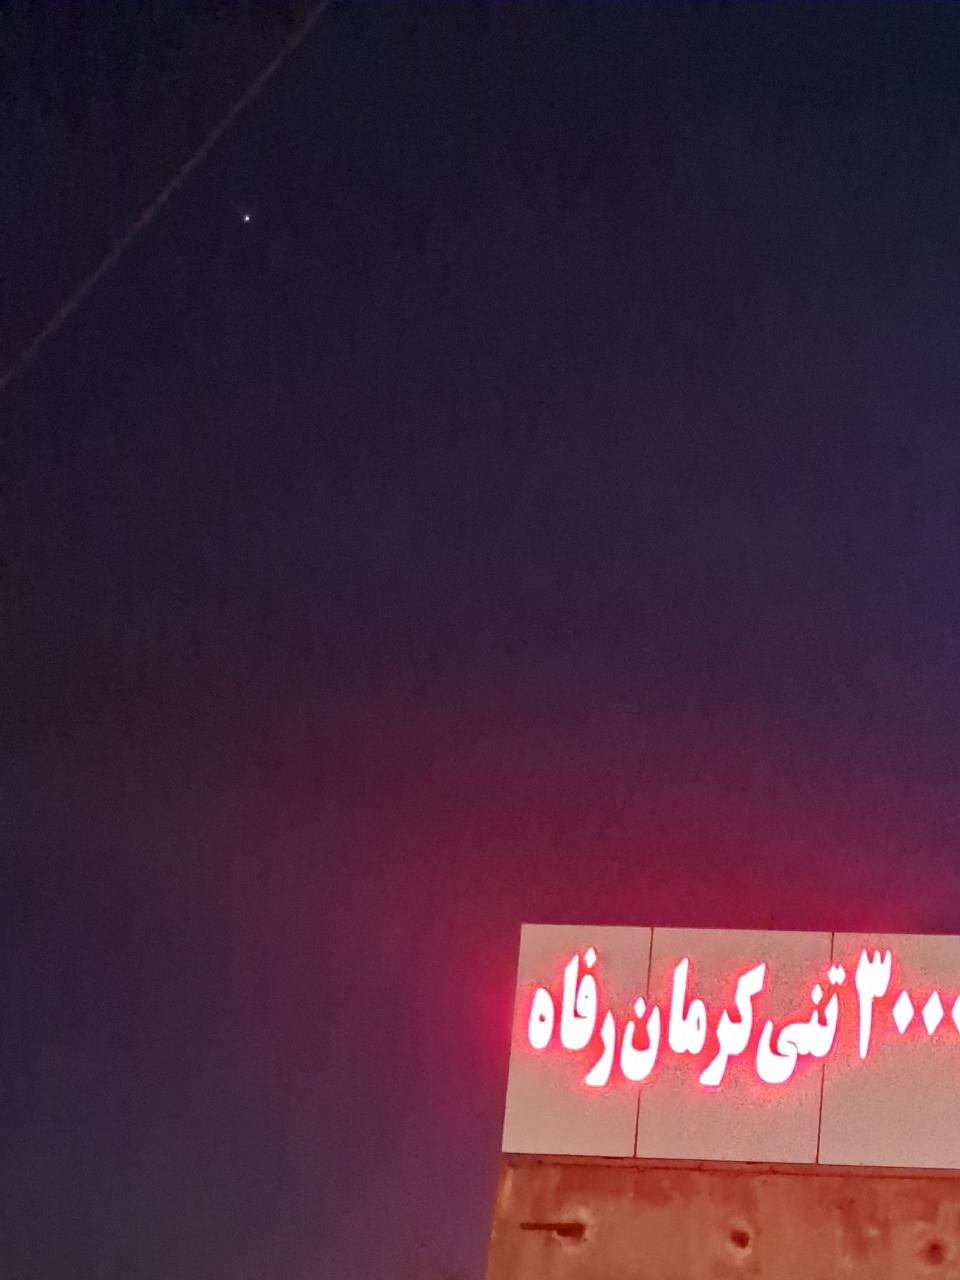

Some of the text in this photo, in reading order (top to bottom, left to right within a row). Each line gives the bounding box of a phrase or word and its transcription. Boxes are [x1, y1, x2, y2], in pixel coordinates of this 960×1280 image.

[528, 947, 616, 1087] رفاه
[620, 958, 766, 1087] کرمان
[756, 966, 846, 1084] تنی
